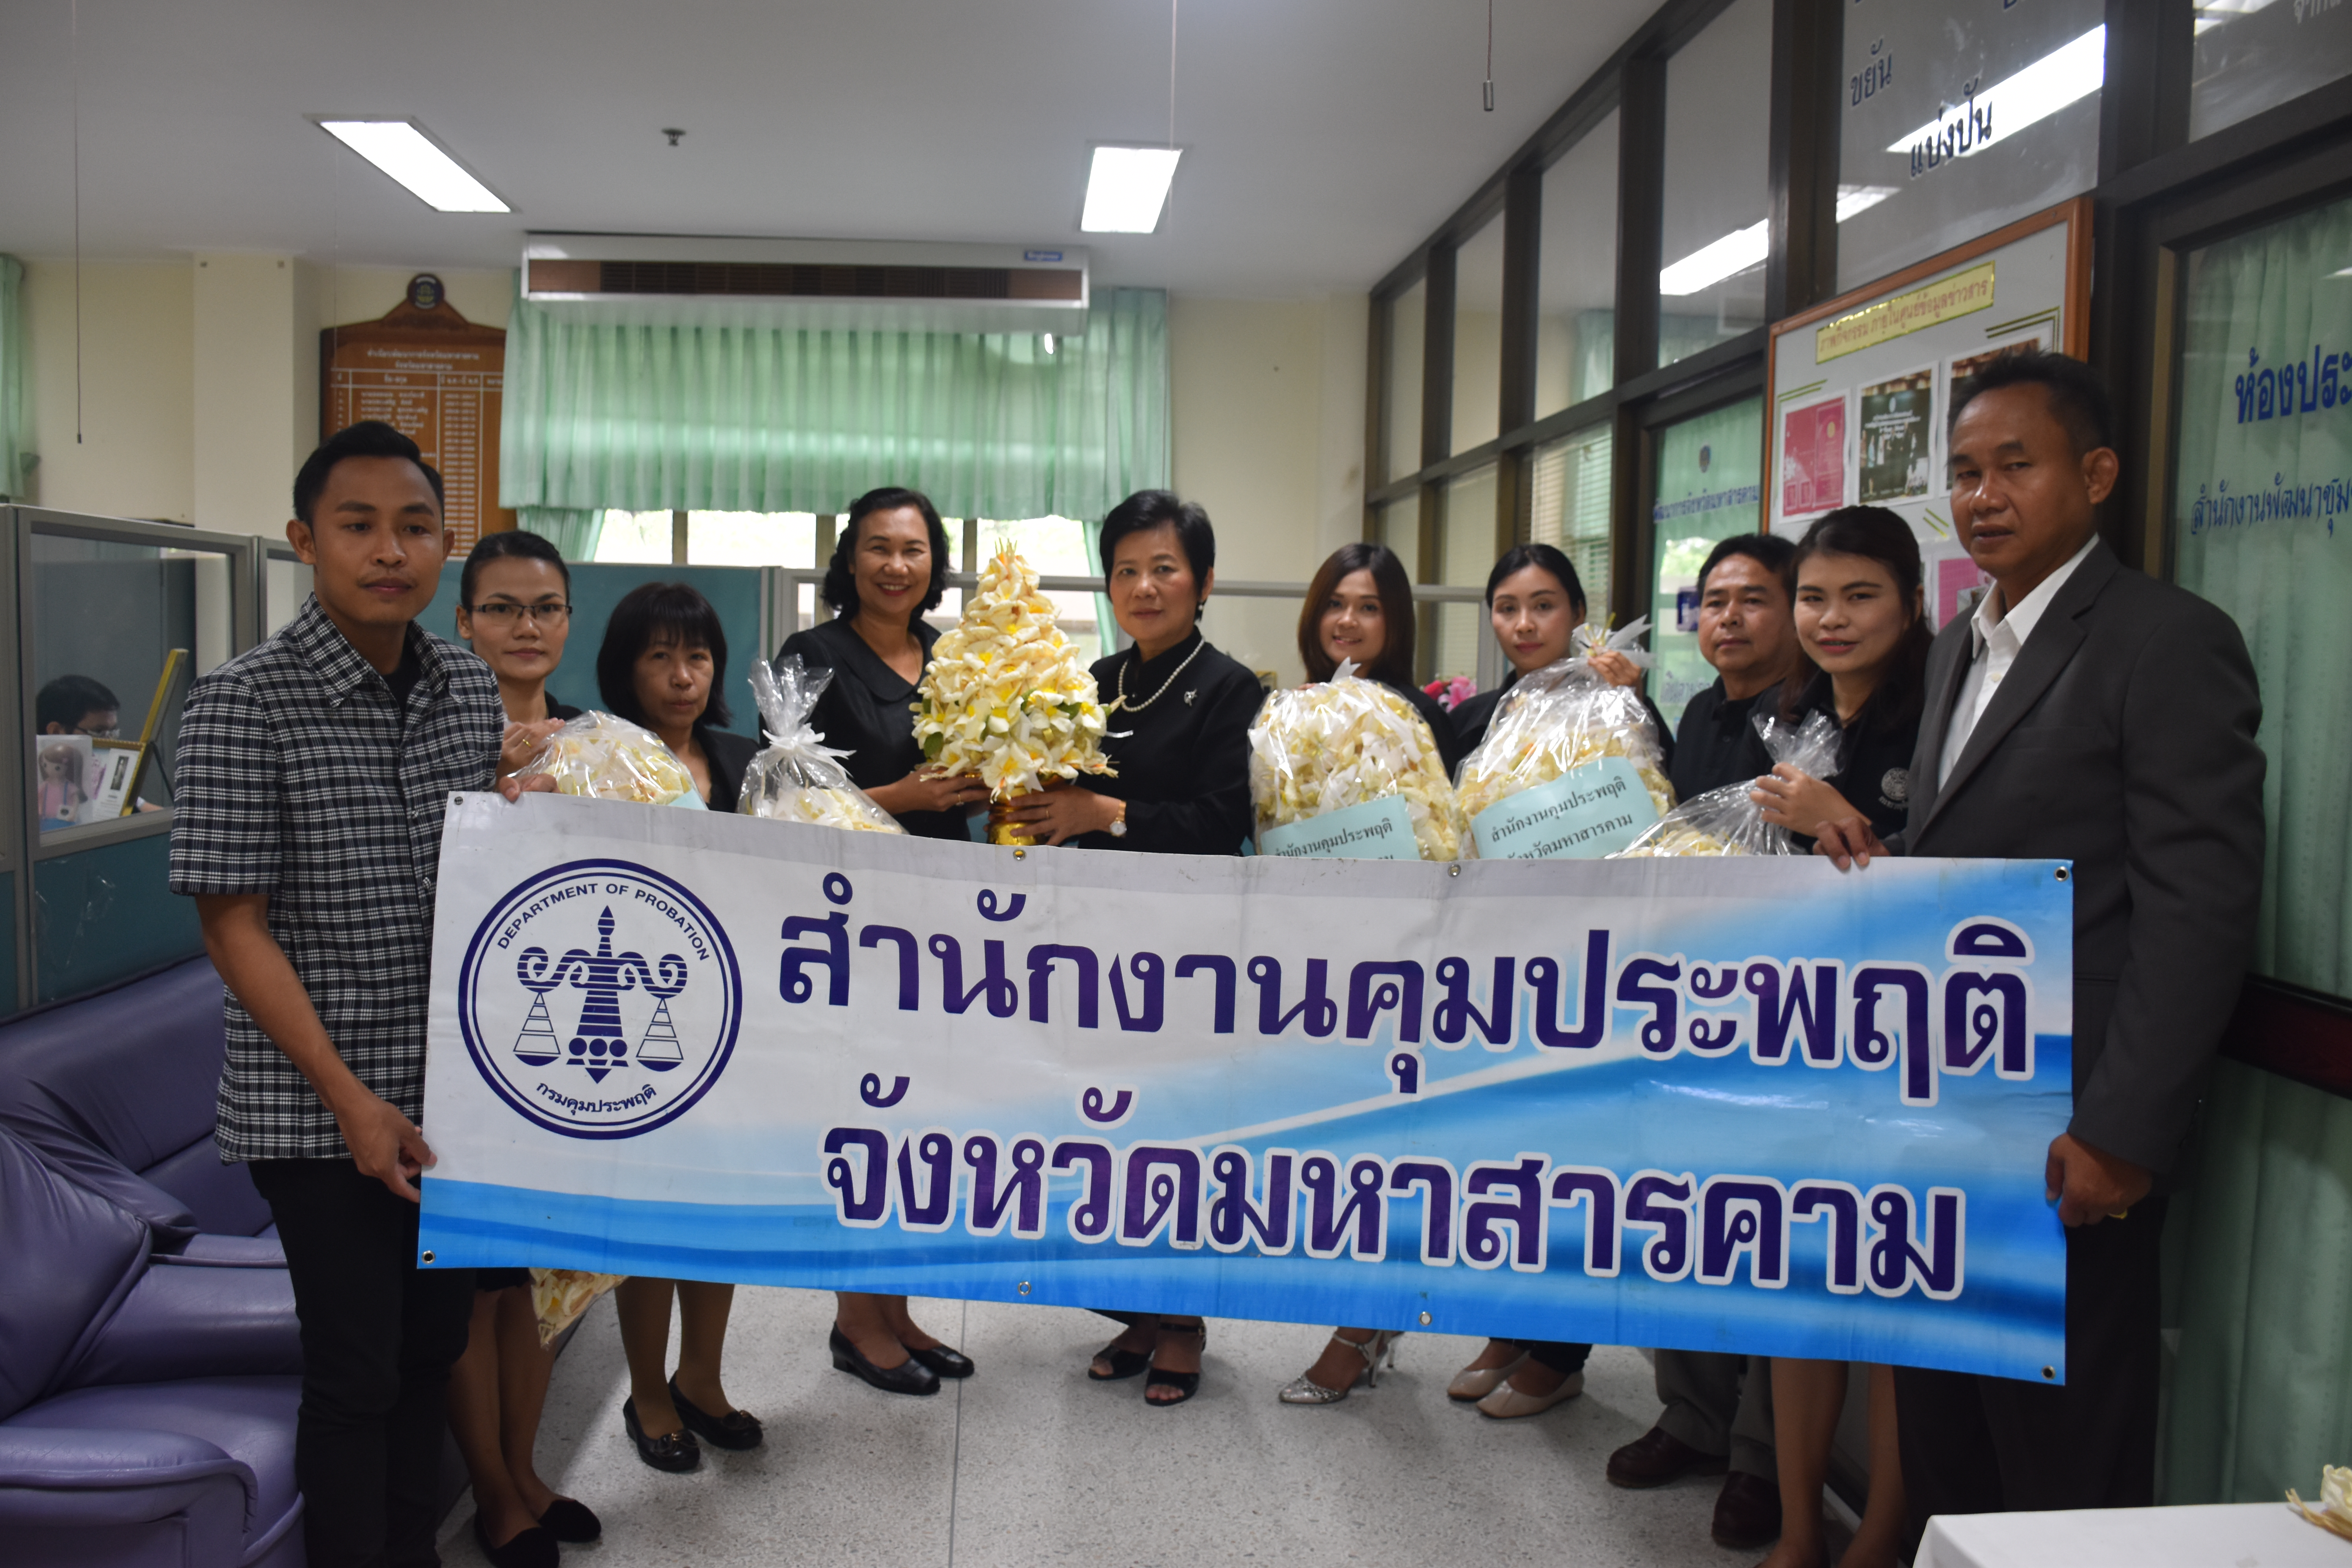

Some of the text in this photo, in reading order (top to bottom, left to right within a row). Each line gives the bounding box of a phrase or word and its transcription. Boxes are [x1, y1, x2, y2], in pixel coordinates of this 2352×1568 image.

[1850, 38, 1892, 107] ขยัน
[1911, 77, 1993, 178] แบ่งปัน
[2192, 472, 2352, 539] สำนักงานพัฒนาชุม
[1491, 775, 1627, 842] สำนักงานคุมประพฤติ
[497, 883, 710, 961] DEPARTMENT OF PROBATION
[779, 872, 2027, 1098] สำนักงานคุมประพฤติ
[536, 1083, 657, 1115] กรมคุมประพฤติ
[824, 1073, 1957, 1292] จังหวัดมหาสารคาม
